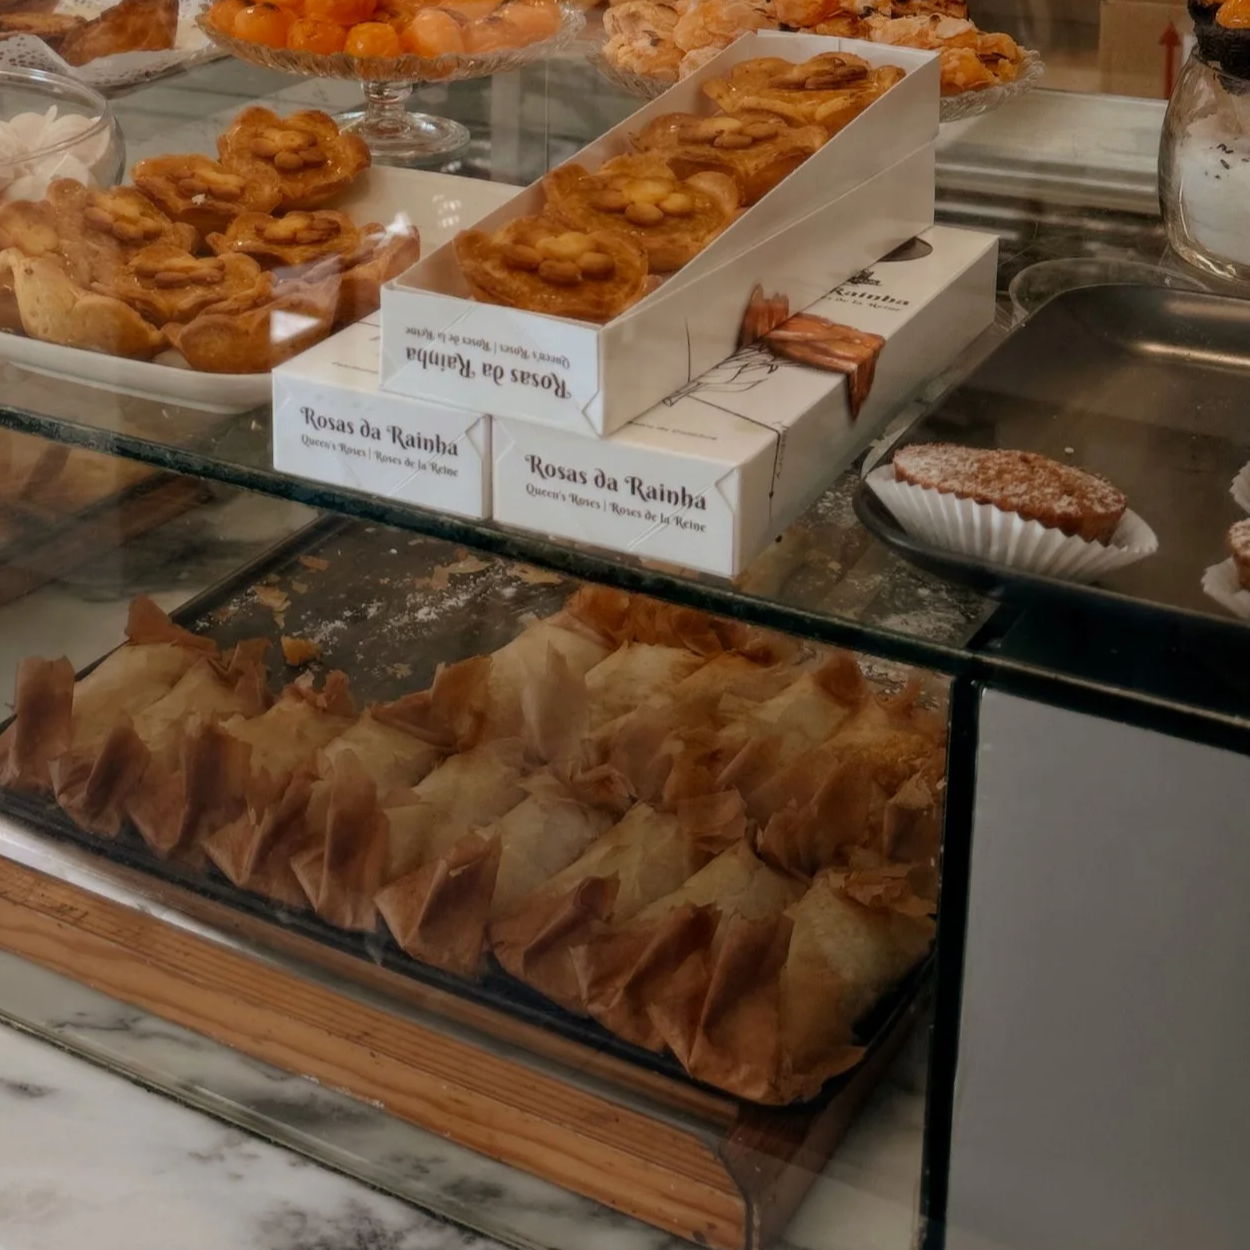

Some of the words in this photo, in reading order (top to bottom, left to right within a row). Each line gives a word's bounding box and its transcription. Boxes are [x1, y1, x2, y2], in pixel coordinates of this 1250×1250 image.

[462, 336, 490, 352] Roses
[500, 344, 530, 360] Roses
[405, 346, 476, 379] Rainha
[482, 361, 504, 386] da
[510, 368, 572, 399] Rosas
[300, 406, 355, 435] Rosas
[359, 418, 381, 440] da
[385, 425, 459, 456] Rainha
[301, 434, 336, 451] Queen's
[338, 442, 366, 458] Roses
[374, 451, 402, 466] Roses
[404, 457, 416, 469] de
[417, 459, 427, 471] la
[429, 461, 459, 477] Reine
[524, 454, 588, 485] Rosas
[593, 468, 619, 493] da
[624, 475, 707, 511] Rainha
[525, 483, 566, 502] Queen's
[568, 493, 601, 510] Roses
[609, 502, 642, 519] Roses
[644, 509, 657, 522] de
[660, 512, 670, 525] la
[672, 515, 707, 532] Reine
